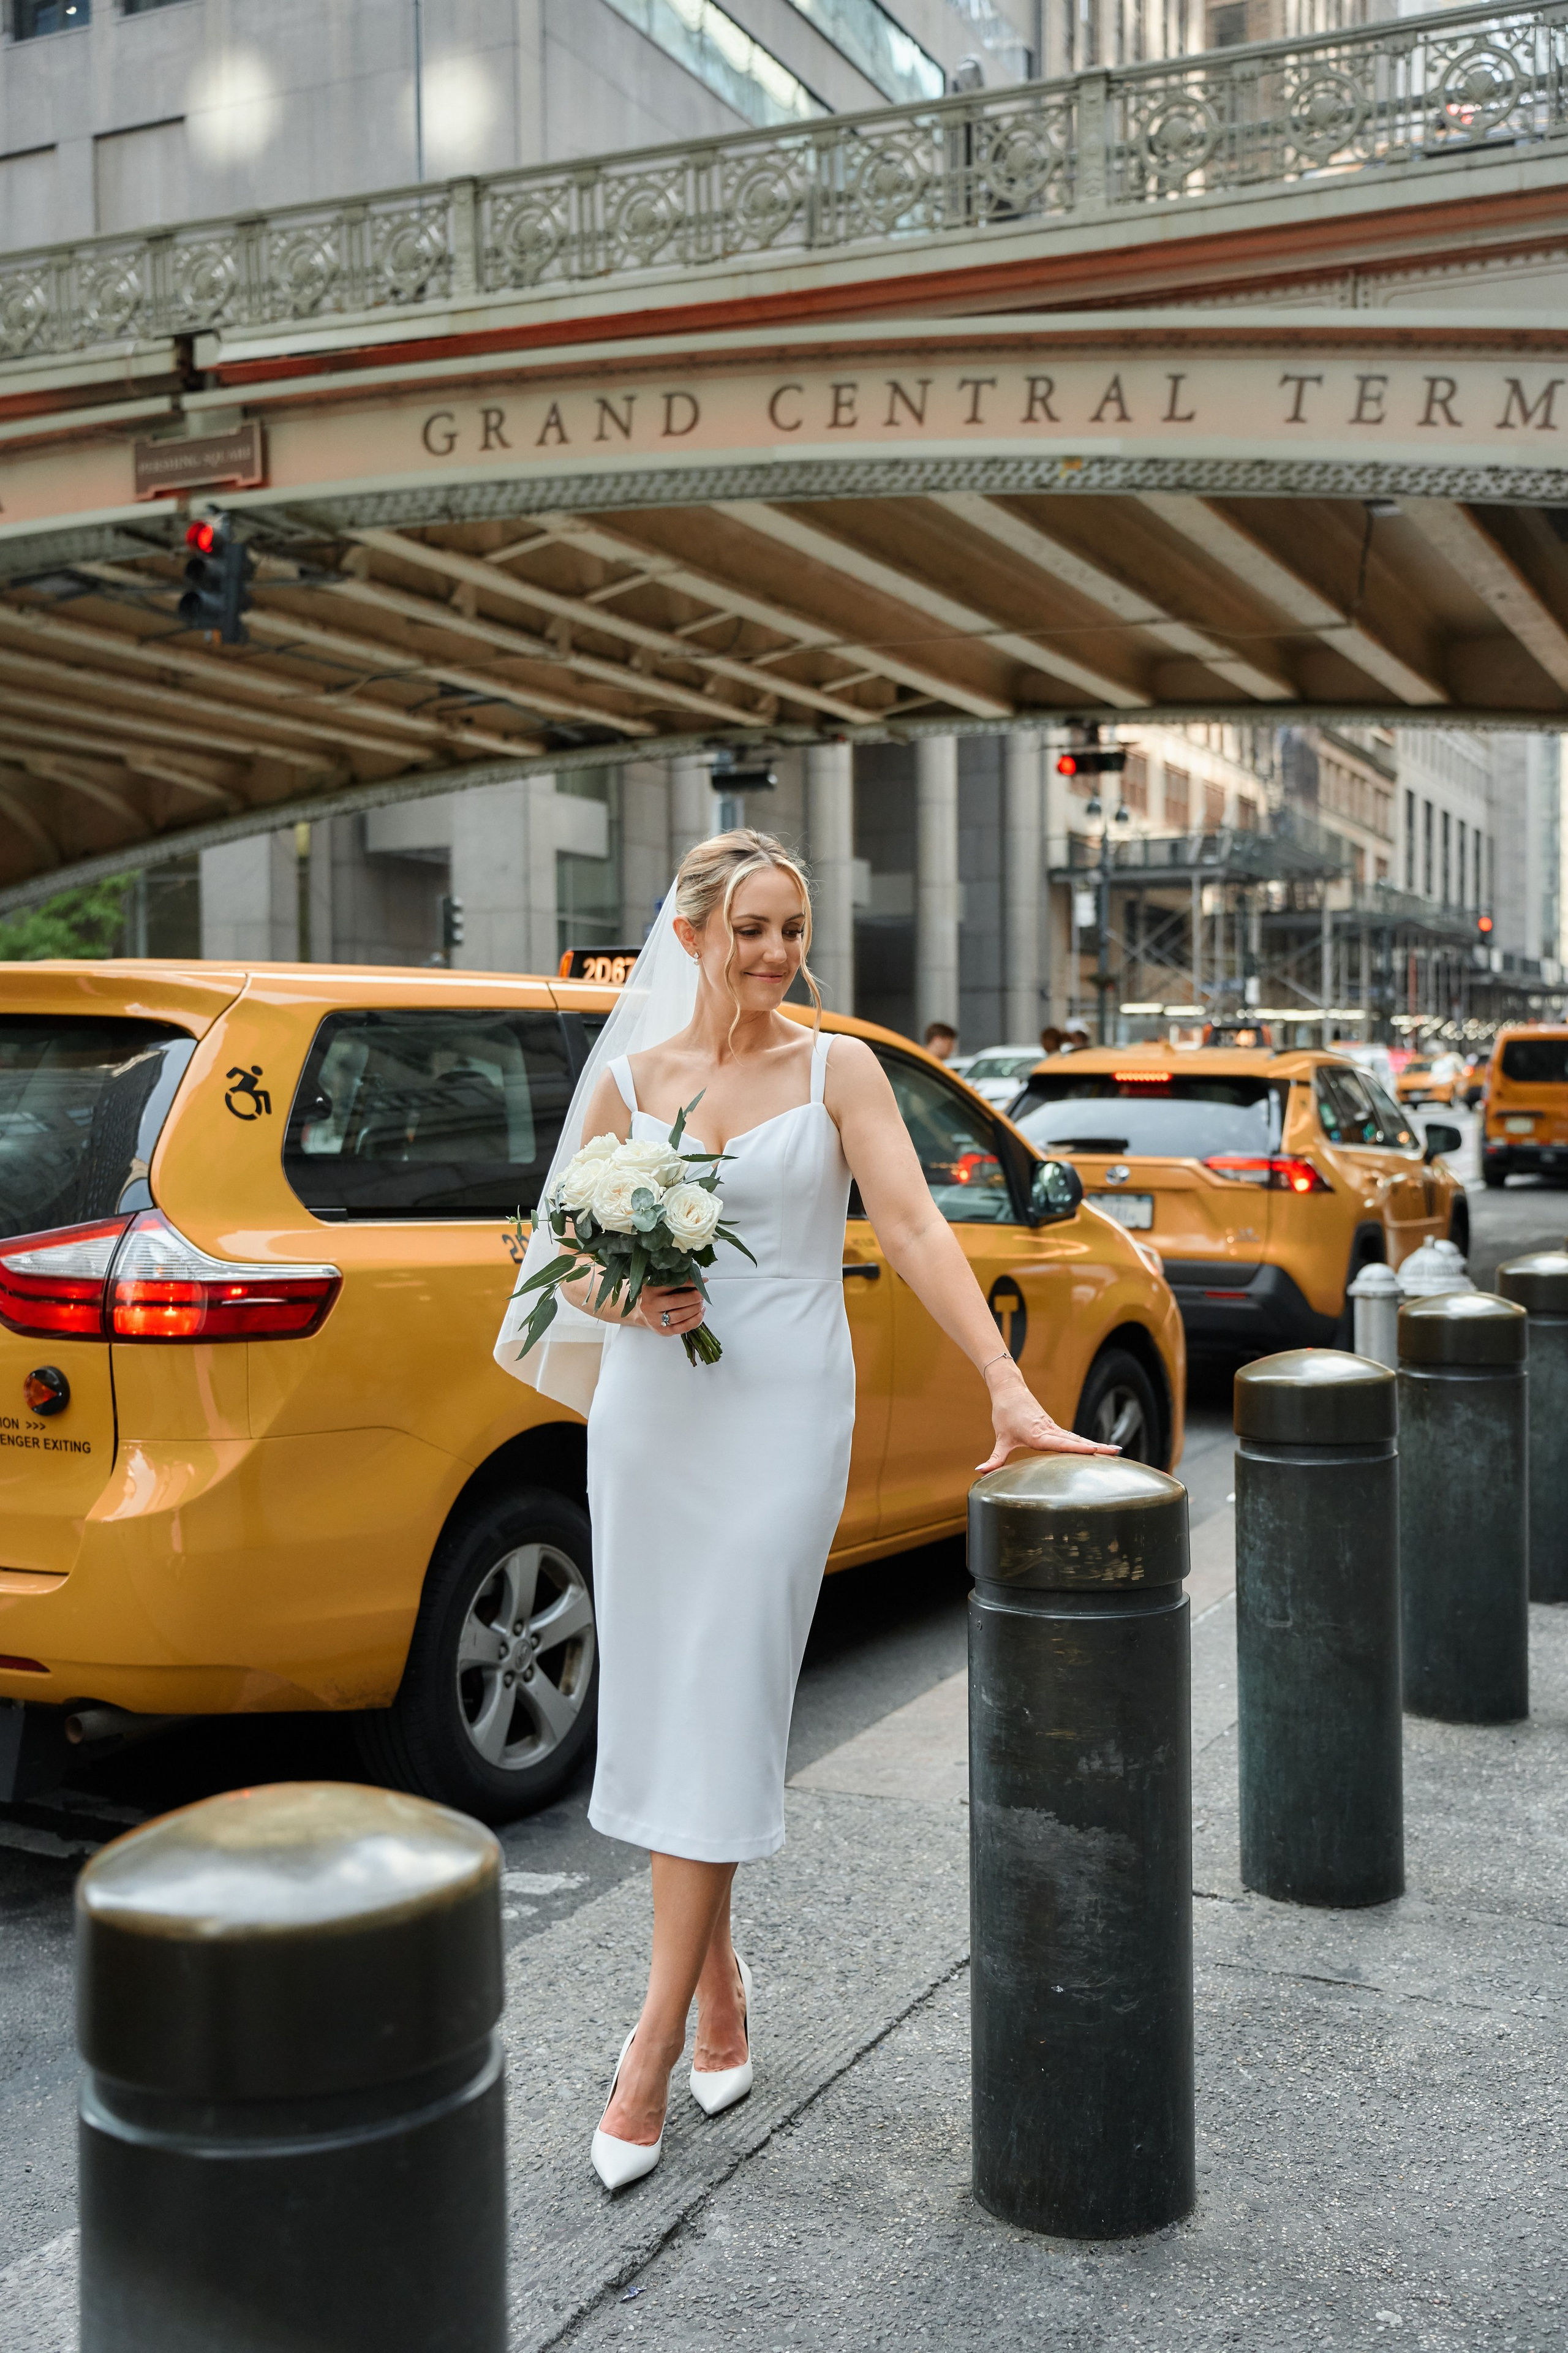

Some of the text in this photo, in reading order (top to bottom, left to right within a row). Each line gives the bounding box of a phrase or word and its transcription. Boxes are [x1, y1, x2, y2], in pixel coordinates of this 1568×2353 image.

[421, 372, 1566, 456] GRAND CENTRAL TERM
[43, 1438, 91, 1454] EXITING
